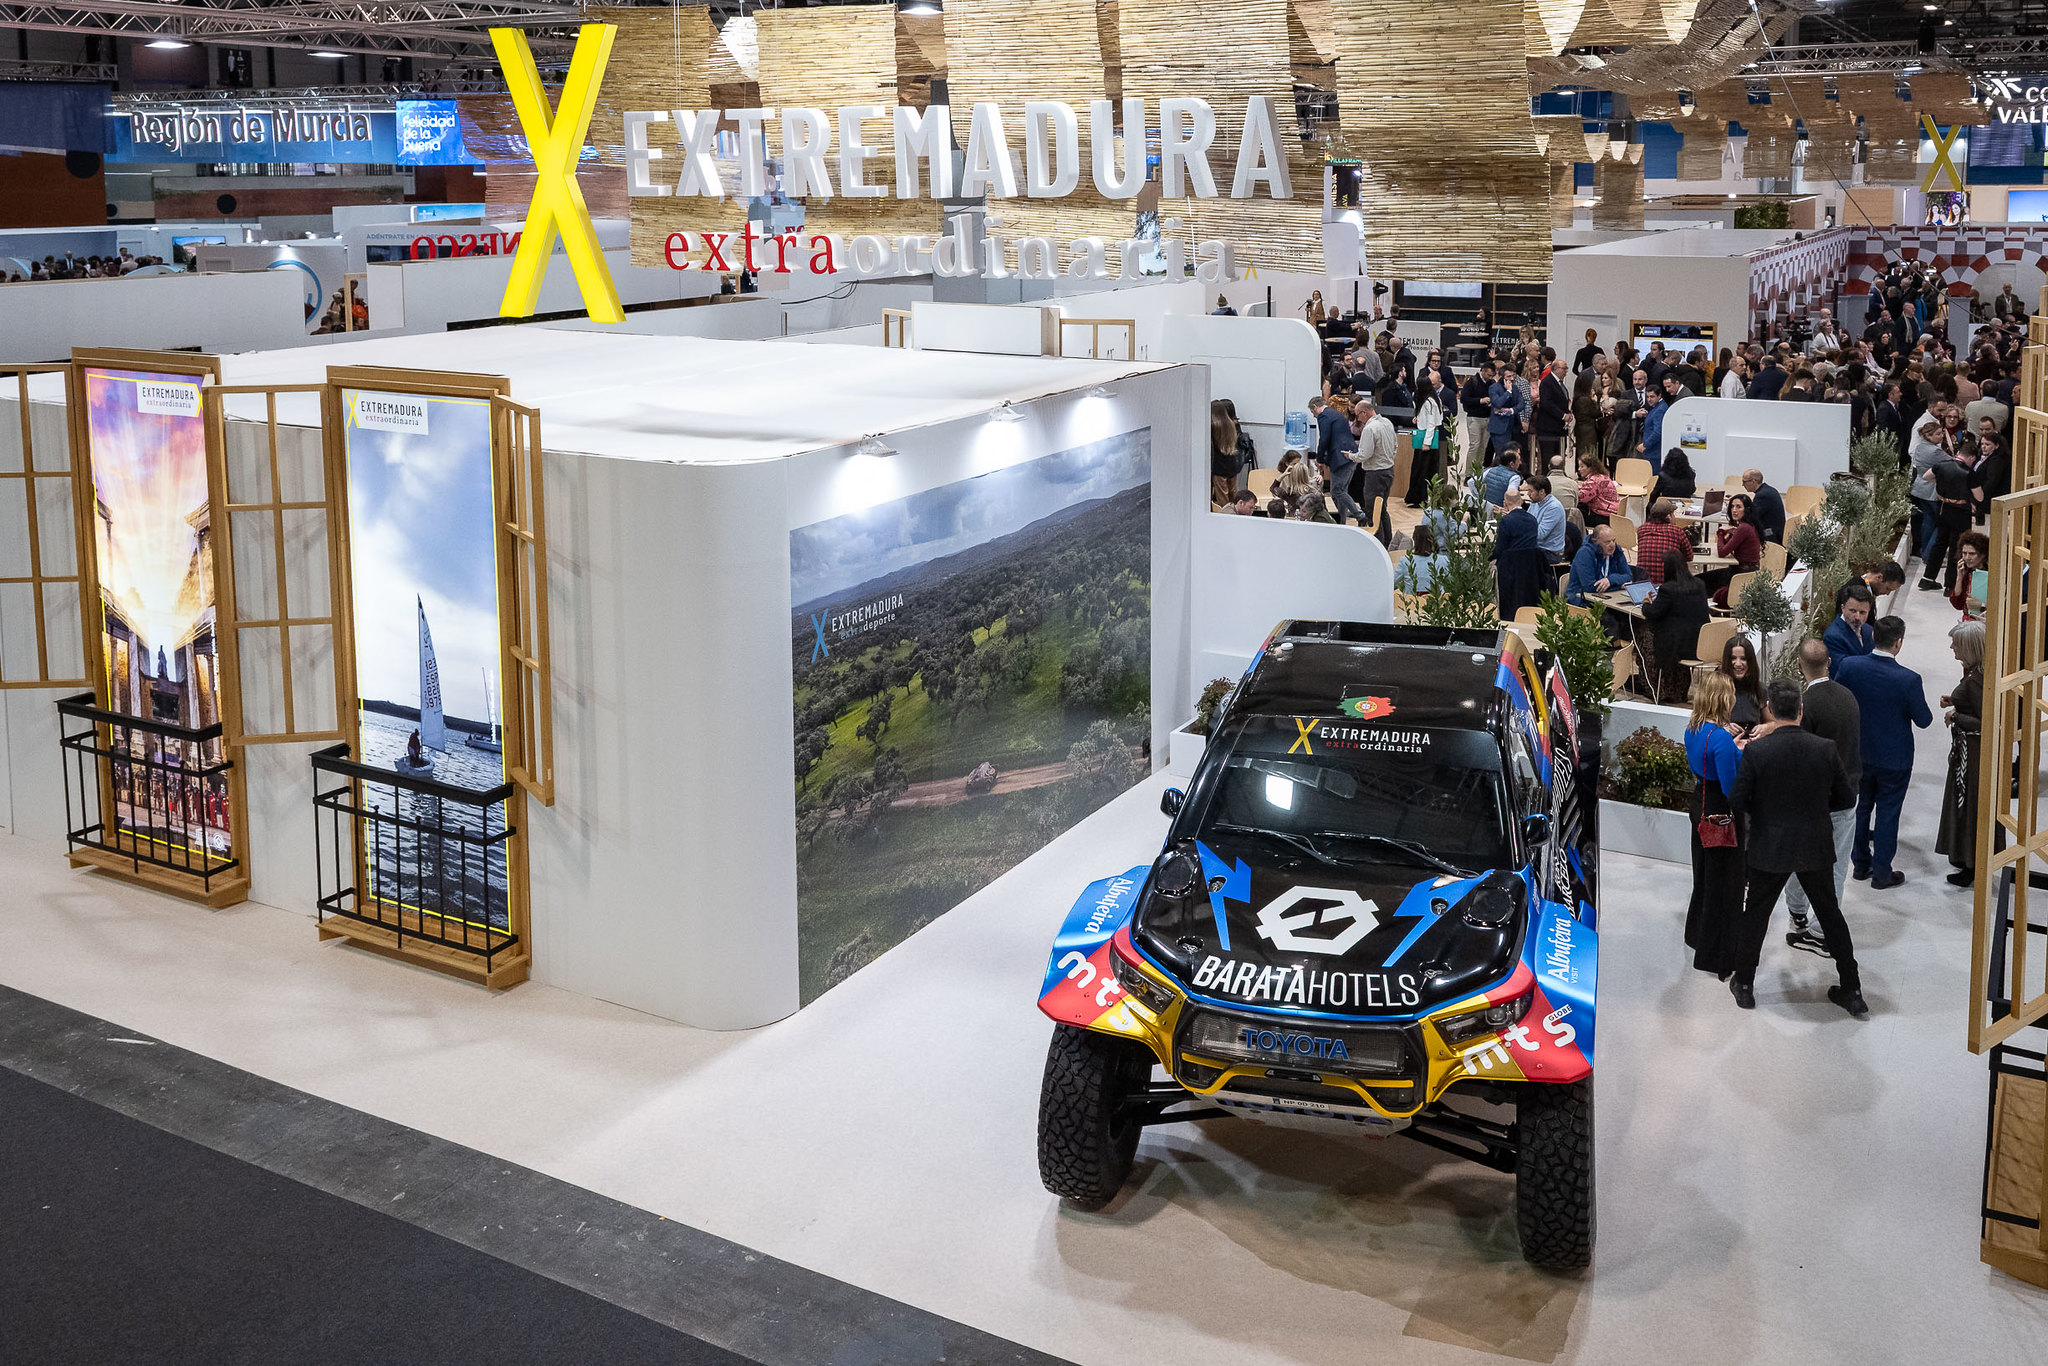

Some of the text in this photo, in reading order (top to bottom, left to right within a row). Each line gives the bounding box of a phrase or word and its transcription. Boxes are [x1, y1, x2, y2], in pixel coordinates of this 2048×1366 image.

[132, 105, 372, 152] Región de Murcia
[403, 115, 455, 128] Felicidad
[403, 127, 430, 139] de la
[403, 139, 441, 151] buena
[623, 95, 1293, 199] EXTREMADURA
[664, 212, 1239, 284] extraordinaria
[142, 387, 194, 401] EXTREMADURA
[146, 399, 191, 409] extraordinaria
[361, 400, 423, 418] EXTREMADURA
[365, 414, 419, 426] extraordinaria
[832, 593, 904, 633] EXTREMADURA
[840, 612, 896, 640] extradeporte
[1320, 726, 1431, 745] EXTREMADURA
[1326, 740, 1422, 753] extraordinaria
[1085, 877, 1134, 934] Albufeira
[1546, 917, 1576, 984] Albufeira
[1571, 967, 1580, 984] VISIT
[1548, 1005, 1573, 1022] GLOBE
[1242, 1029, 1349, 1060] TOYOTA
[1463, 1009, 1576, 1076] mts
